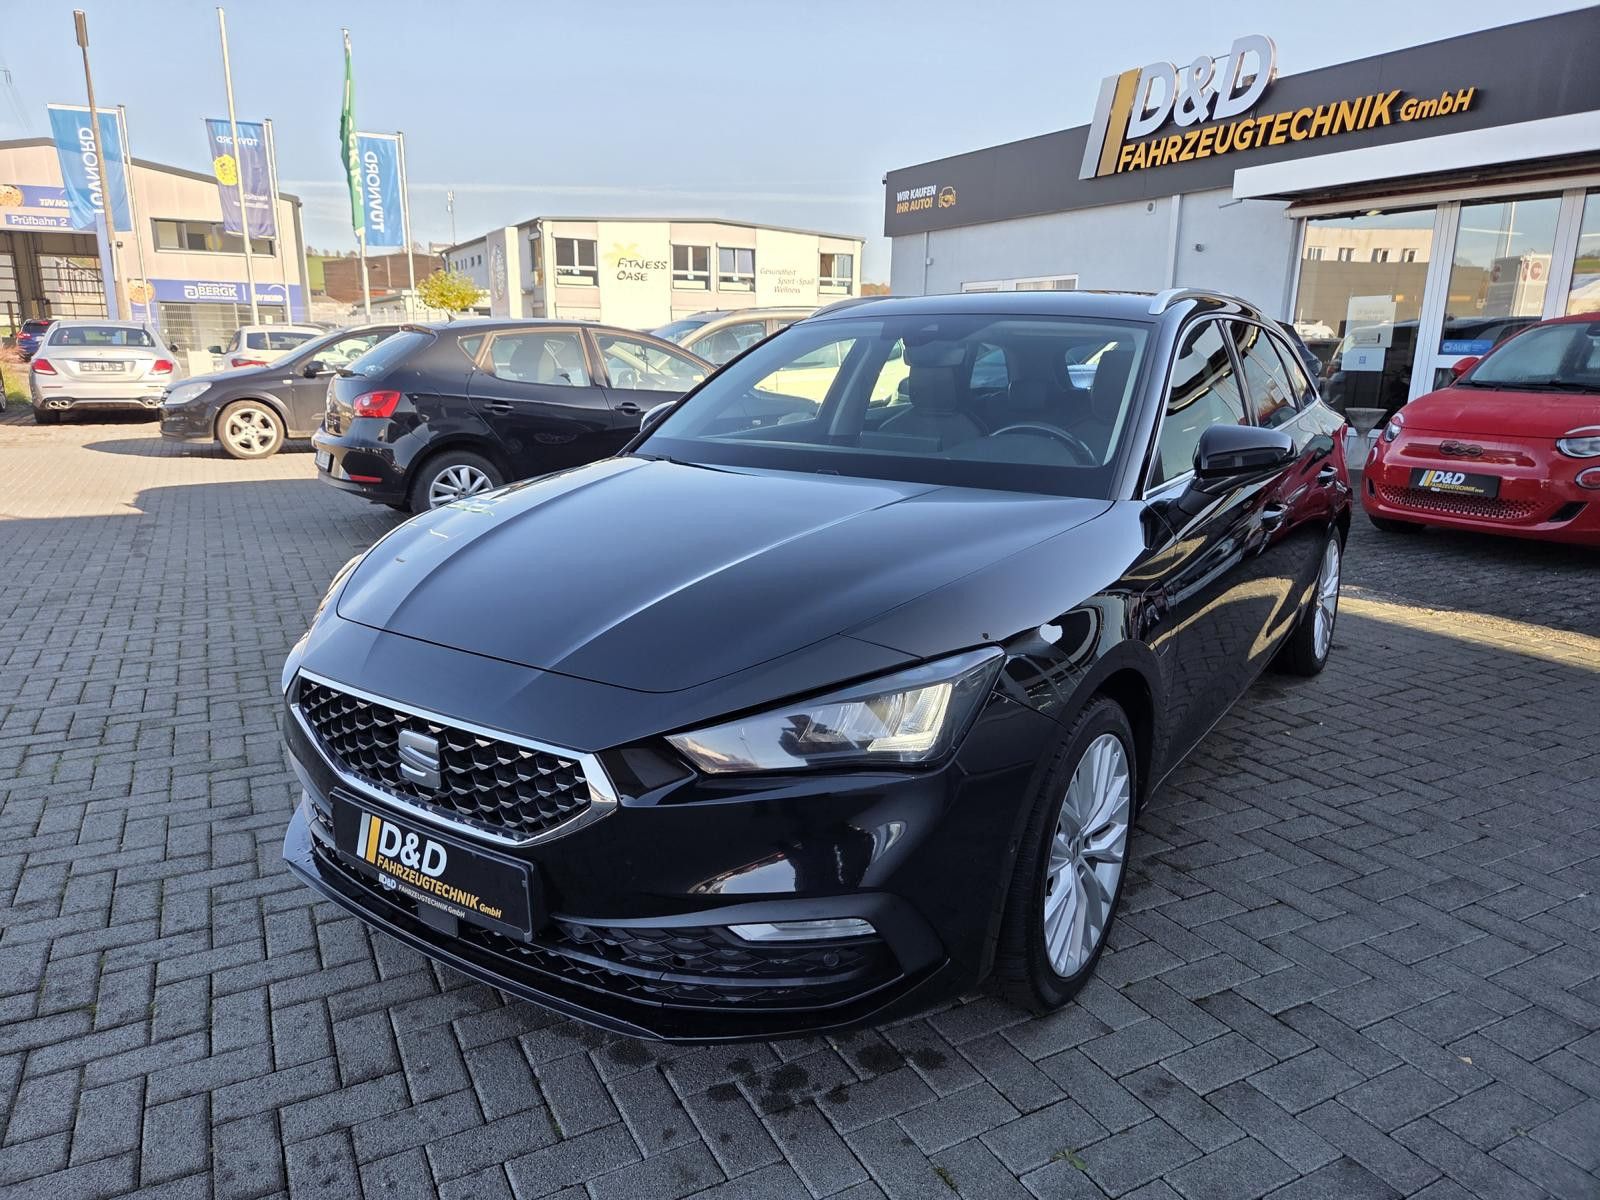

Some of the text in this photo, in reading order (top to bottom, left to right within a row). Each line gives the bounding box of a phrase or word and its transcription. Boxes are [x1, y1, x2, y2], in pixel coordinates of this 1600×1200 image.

[1126, 33, 1277, 139] D&D
[1117, 87, 1475, 173] FAHRZEUGTECHNIK GmbH
[896, 184, 937, 202] WIR KAUFEN
[896, 197, 934, 214] IHR AUTO!
[11, 215, 68, 226] Prüfbahn 2
[616, 270, 649, 281] OASE
[199, 286, 238, 297] BERGK
[1432, 470, 1466, 485] D&D
[378, 821, 448, 877] D&D
[376, 855, 502, 919] FAHRZEUGTECHNIK GmbH
[398, 884, 448, 912] FAHRZEUGTECHNIK
[447, 905, 466, 919] GmbH
